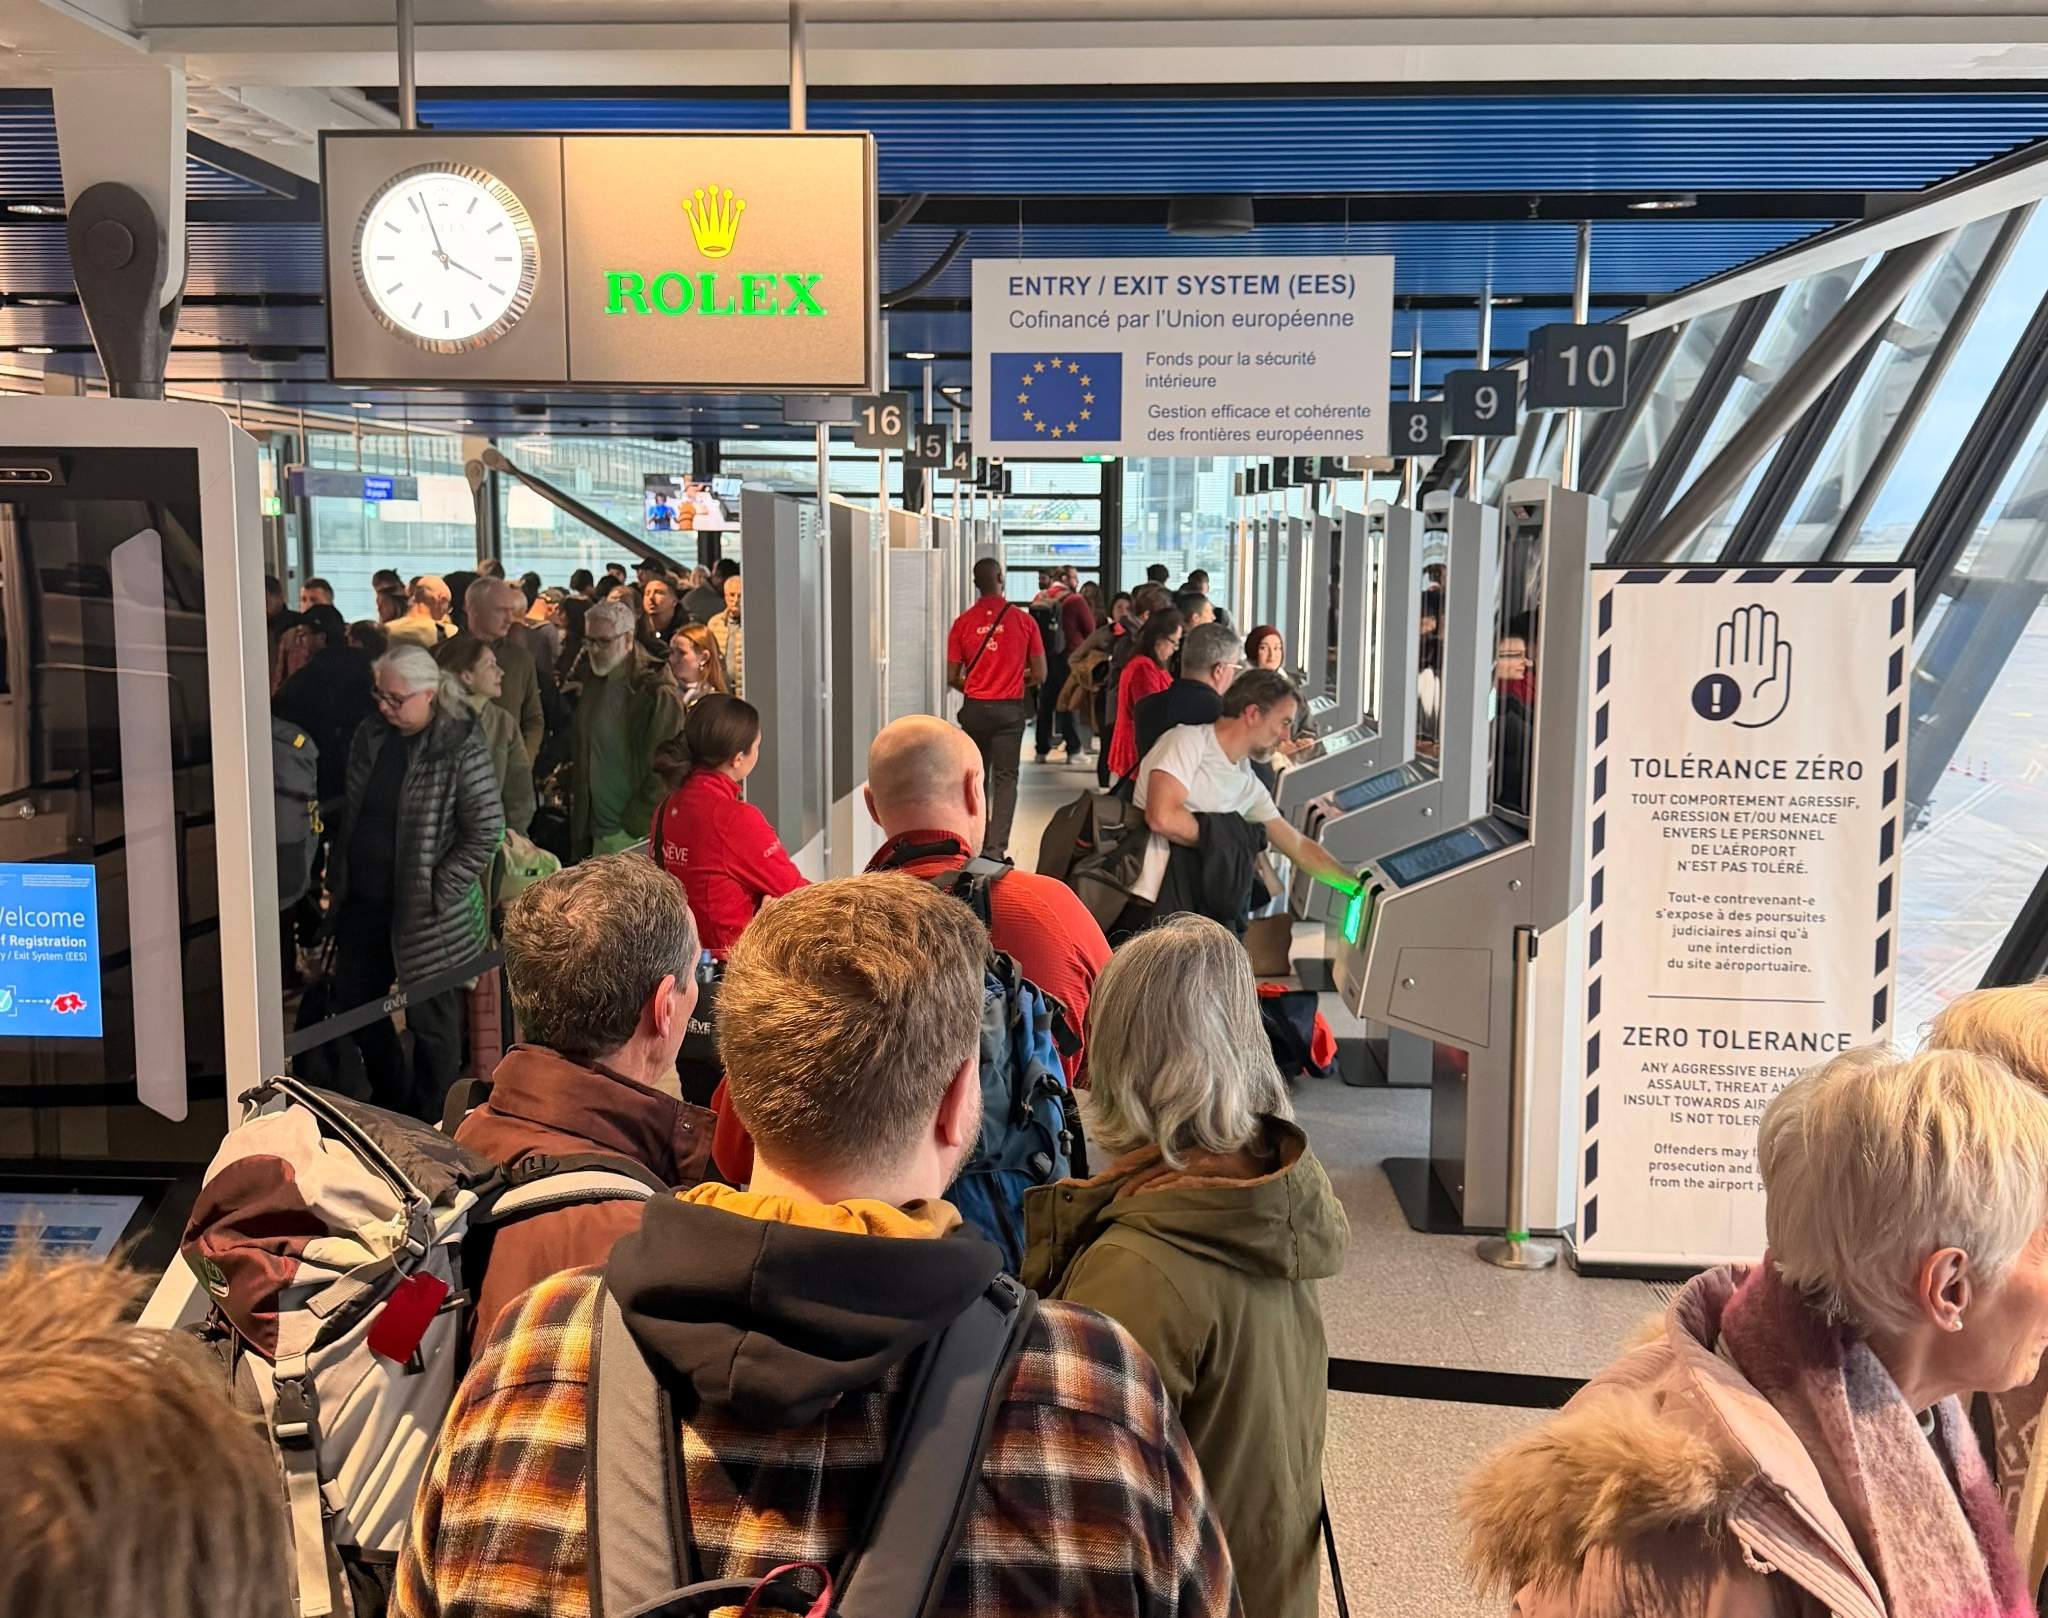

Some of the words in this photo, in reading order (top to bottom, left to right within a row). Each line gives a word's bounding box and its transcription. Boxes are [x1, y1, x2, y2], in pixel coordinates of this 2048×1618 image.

[603, 271, 828, 316] ROLEX
[1010, 276, 1091, 295] ENTRY
[1098, 276, 1105, 295] /
[1114, 276, 1168, 295] EXIT
[1177, 275, 1279, 295] SYSTEM
[1289, 274, 1355, 299] (EES)
[1010, 310, 1109, 328] Cofinancé
[1117, 314, 1150, 332] par
[1157, 310, 1224, 327] l'Union
[1232, 309, 1353, 331] européenne
[1146, 352, 1193, 366] Fonds
[1198, 355, 1233, 368] pour
[1238, 352, 1250, 365] la
[1256, 351, 1316, 365] sécurité
[1559, 345, 1616, 387] 10
[1146, 374, 1216, 388] intérieure
[1148, 404, 1206, 418] Gestion
[1211, 404, 1270, 418] efficace
[1275, 405, 1290, 418] et
[1294, 404, 1371, 418] cohérente
[1475, 386, 1498, 420] 9
[862, 405, 901, 436] 16
[1408, 414, 1428, 442] 8
[1148, 428, 1174, 441] des
[1180, 427, 1250, 441] frontières
[1256, 426, 1363, 444] européennes
[914, 434, 941, 458] 15
[954, 451, 968, 470] 4
[1630, 753, 1787, 779] TOLÉRANCE
[1796, 754, 1862, 780] ZÉRO
[1632, 794, 1666, 804] TOUT
[1670, 794, 1784, 806] COMPORTEMENT
[1789, 796, 1860, 809] AGRESSIF,
[1652, 811, 1729, 822] AGRESSION
[1734, 811, 1775, 823] ET/OU
[1780, 813, 1837, 824] MENACE
[1663, 827, 1716, 839] ENVERS
[1721, 828, 1738, 839] LE
[1742, 829, 1824, 840] PERSONNEL
[1692, 844, 1709, 855] DE
[1713, 842, 1796, 856] L'AÉROPORT
[1678, 861, 1717, 872] N'EST
[1722, 862, 1747, 872] PAS
[1751, 860, 1808, 874] TOLÉRÉ.
[1714, 894, 1815, 905] contrevenant-e
[1656, 908, 1713, 921] s'expose
[1717, 909, 1724, 920] à
[1729, 910, 1751, 921] des
[1756, 912, 1826, 923] poursuites
[1672, 925, 1741, 937] judiciaires
[1745, 927, 1776, 938] ainsi
[1780, 928, 1808, 941] qu'à
[9, 934, 87, 949] Registration
[1688, 945, 1712, 953] une
[1716, 943, 1792, 955] interdiction
[14, 951, 29, 960] Exit
[32, 952, 63, 963] System
[65, 952, 88, 962] (EES)
[1668, 958, 1683, 968] du
[1688, 958, 1711, 969] site
[1715, 959, 1811, 972] aéroportuaire.
[1623, 1027, 1687, 1047] ZERO
[1697, 1029, 1851, 1052] TOLERANCE
[1641, 1062, 1668, 1073] ANY
[1672, 1063, 1756, 1076] AGGRESSIVE
[1760, 1066, 1807, 1079] BEHAV
[1647, 1079, 1711, 1092] ASSAULT,
[1715, 1081, 1767, 1093] THREAT
[1624, 1095, 1670, 1106] INSULT
[1674, 1096, 1740, 1109] TOWARDS
[1671, 1112, 1683, 1123] IS
[1687, 1113, 1714, 1124] NOT
[1717, 1114, 1761, 1128] TOLER
[1654, 1143, 1718, 1156] Offenders
[1722, 1148, 1748, 1159] may
[1649, 1161, 1725, 1172] prosecution
[1728, 1164, 1752, 1174] and
[1650, 1176, 1680, 1187] from
[1684, 1177, 1704, 1188] the
[1708, 1178, 1753, 1192] airport
